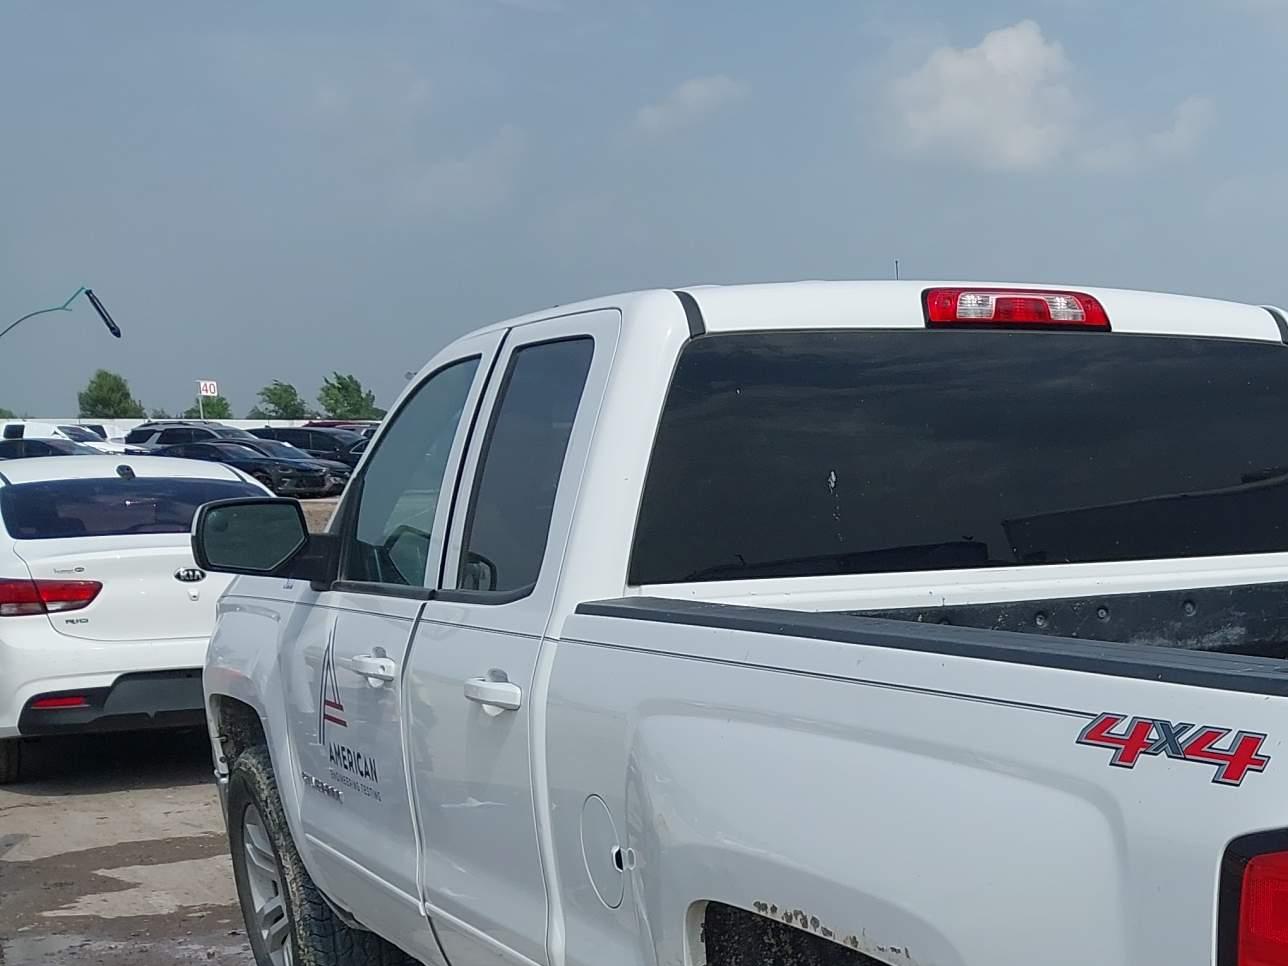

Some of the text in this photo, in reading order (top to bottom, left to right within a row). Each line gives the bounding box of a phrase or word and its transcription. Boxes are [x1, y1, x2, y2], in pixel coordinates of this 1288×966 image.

[201, 382, 216, 395] 40
[178, 568, 204, 581] KIA
[328, 741, 379, 784] AMERICAN
